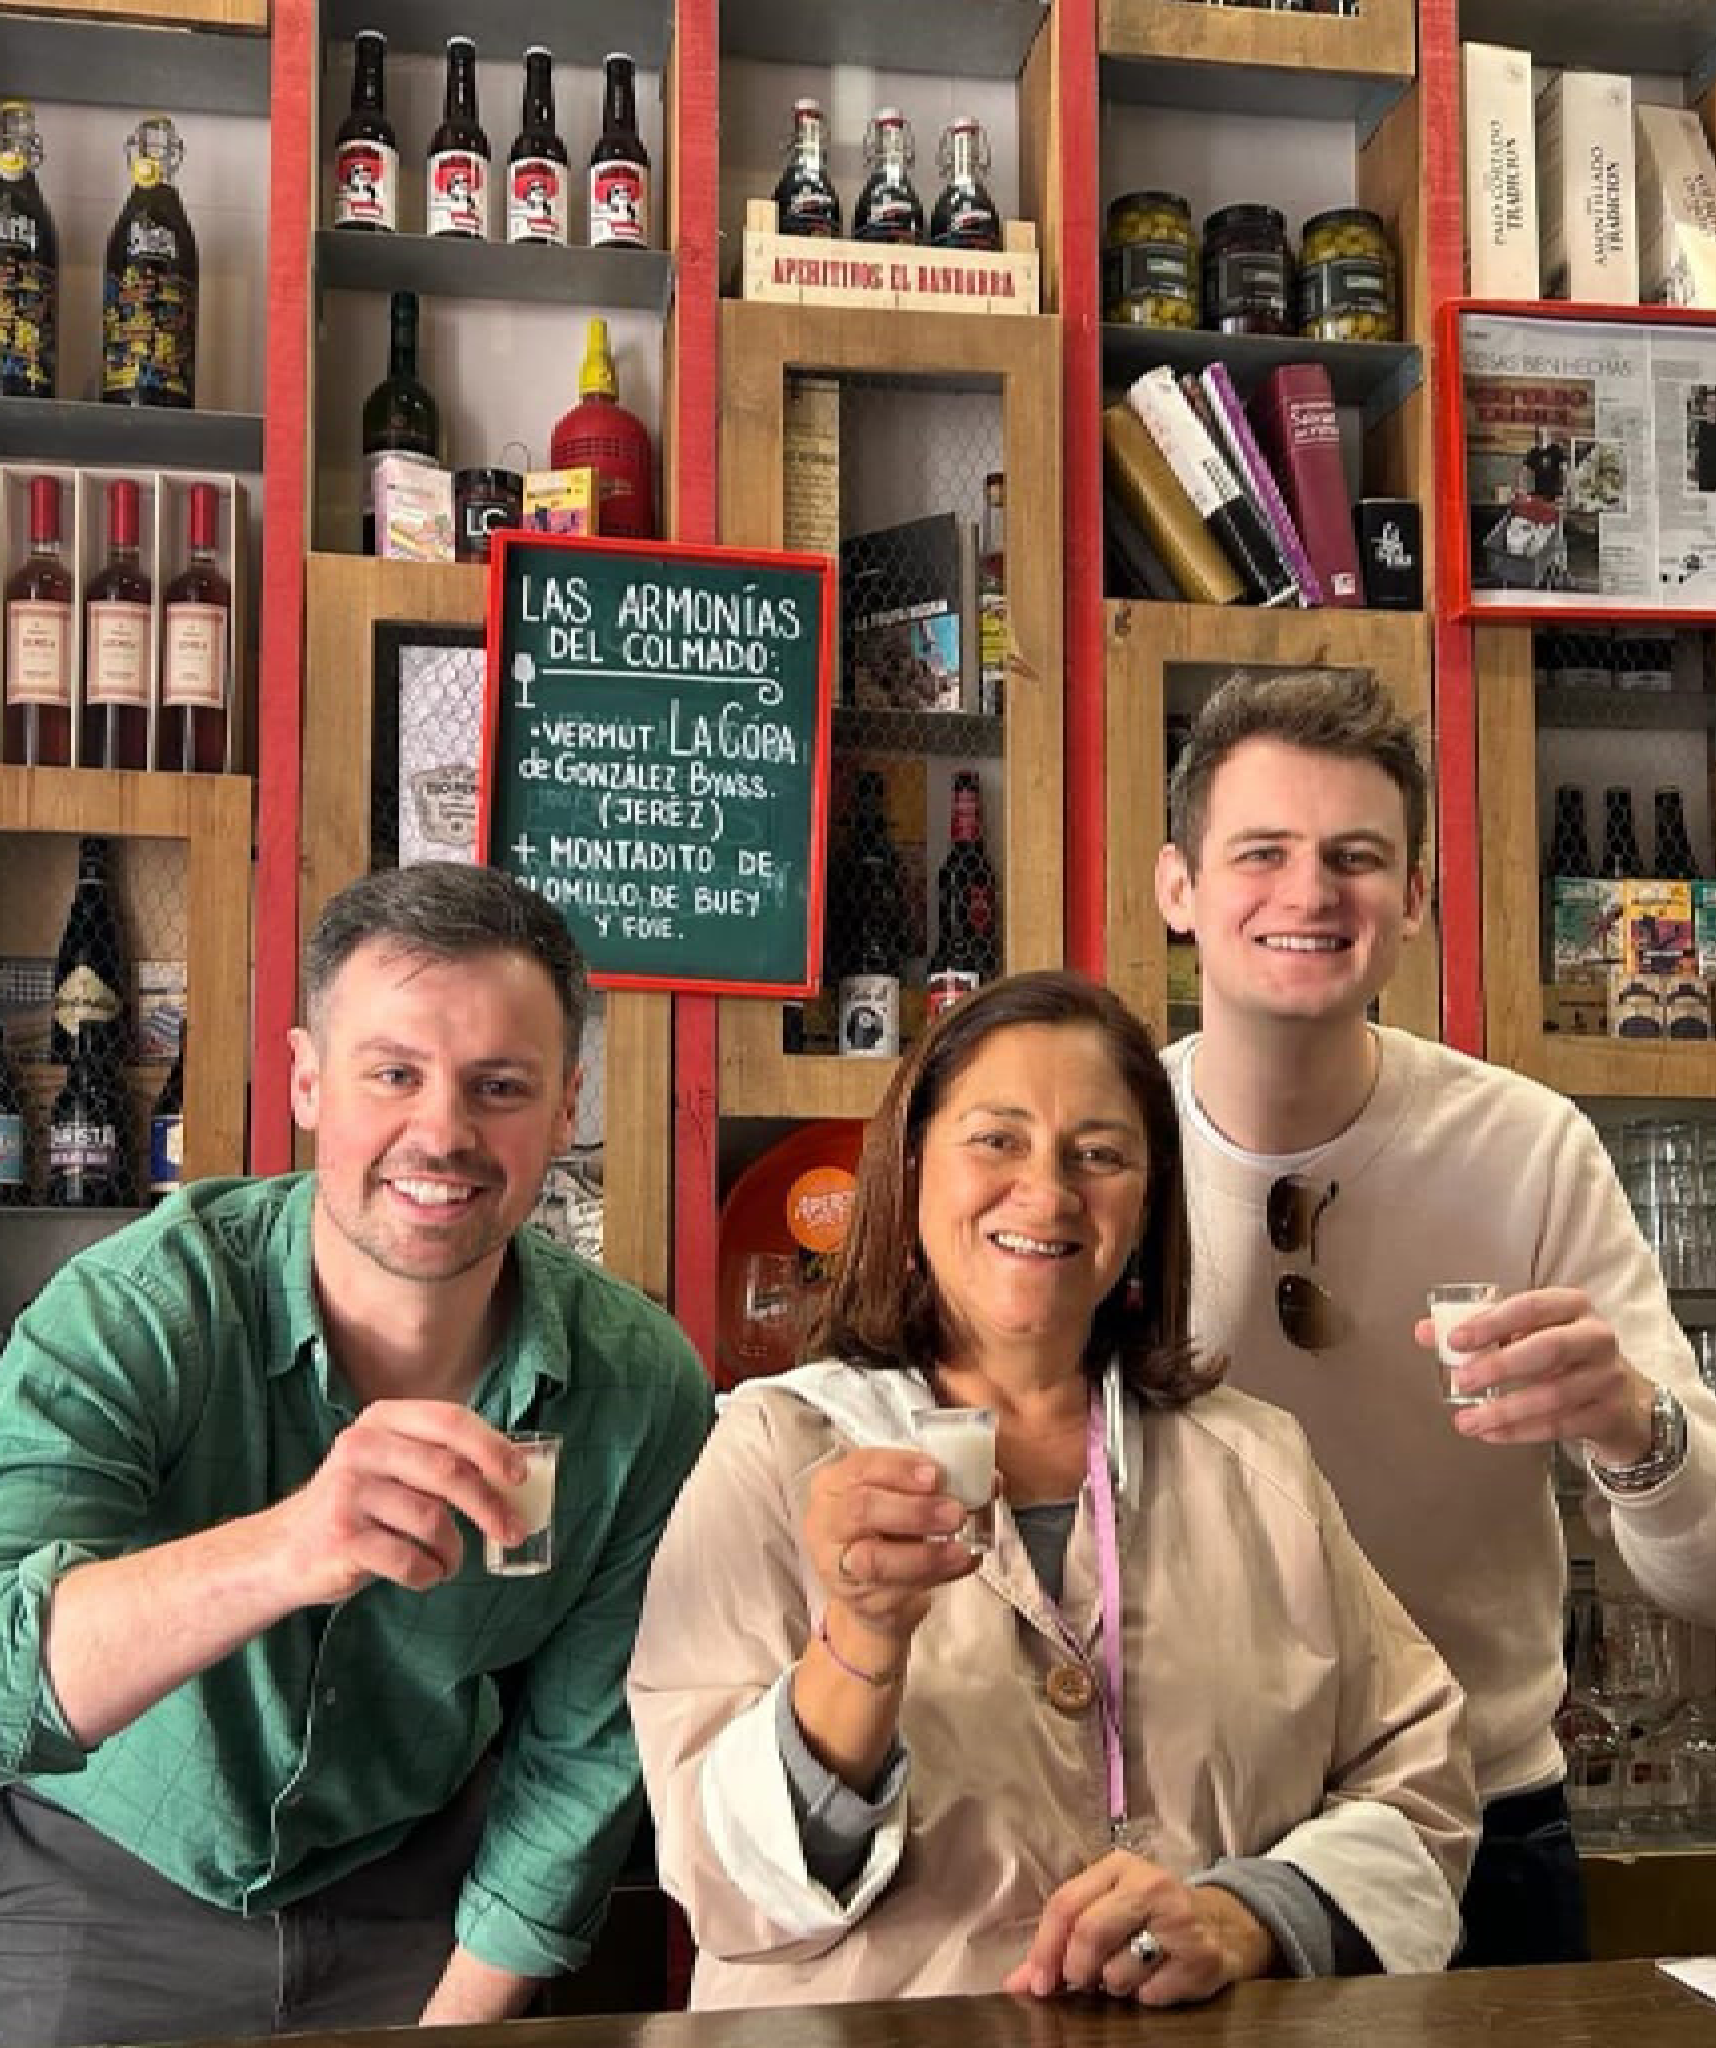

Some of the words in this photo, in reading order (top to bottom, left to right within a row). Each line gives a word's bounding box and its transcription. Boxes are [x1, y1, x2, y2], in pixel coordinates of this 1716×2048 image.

[890, 263, 911, 292] EL
[521, 573, 592, 624] LAS
[615, 583, 801, 639] ARMONÍAS
[549, 626, 604, 664] DEL
[622, 631, 780, 674] COLMADO:
[669, 698, 712, 757] LA
[518, 748, 551, 780] de
[553, 751, 677, 792] GONZÁLEZ
[549, 836, 716, 873] MONTADITO
[737, 849, 774, 878] DE
[649, 884, 680, 909] DE
[694, 887, 760, 917] BUEY
[594, 914, 611, 938] Y
